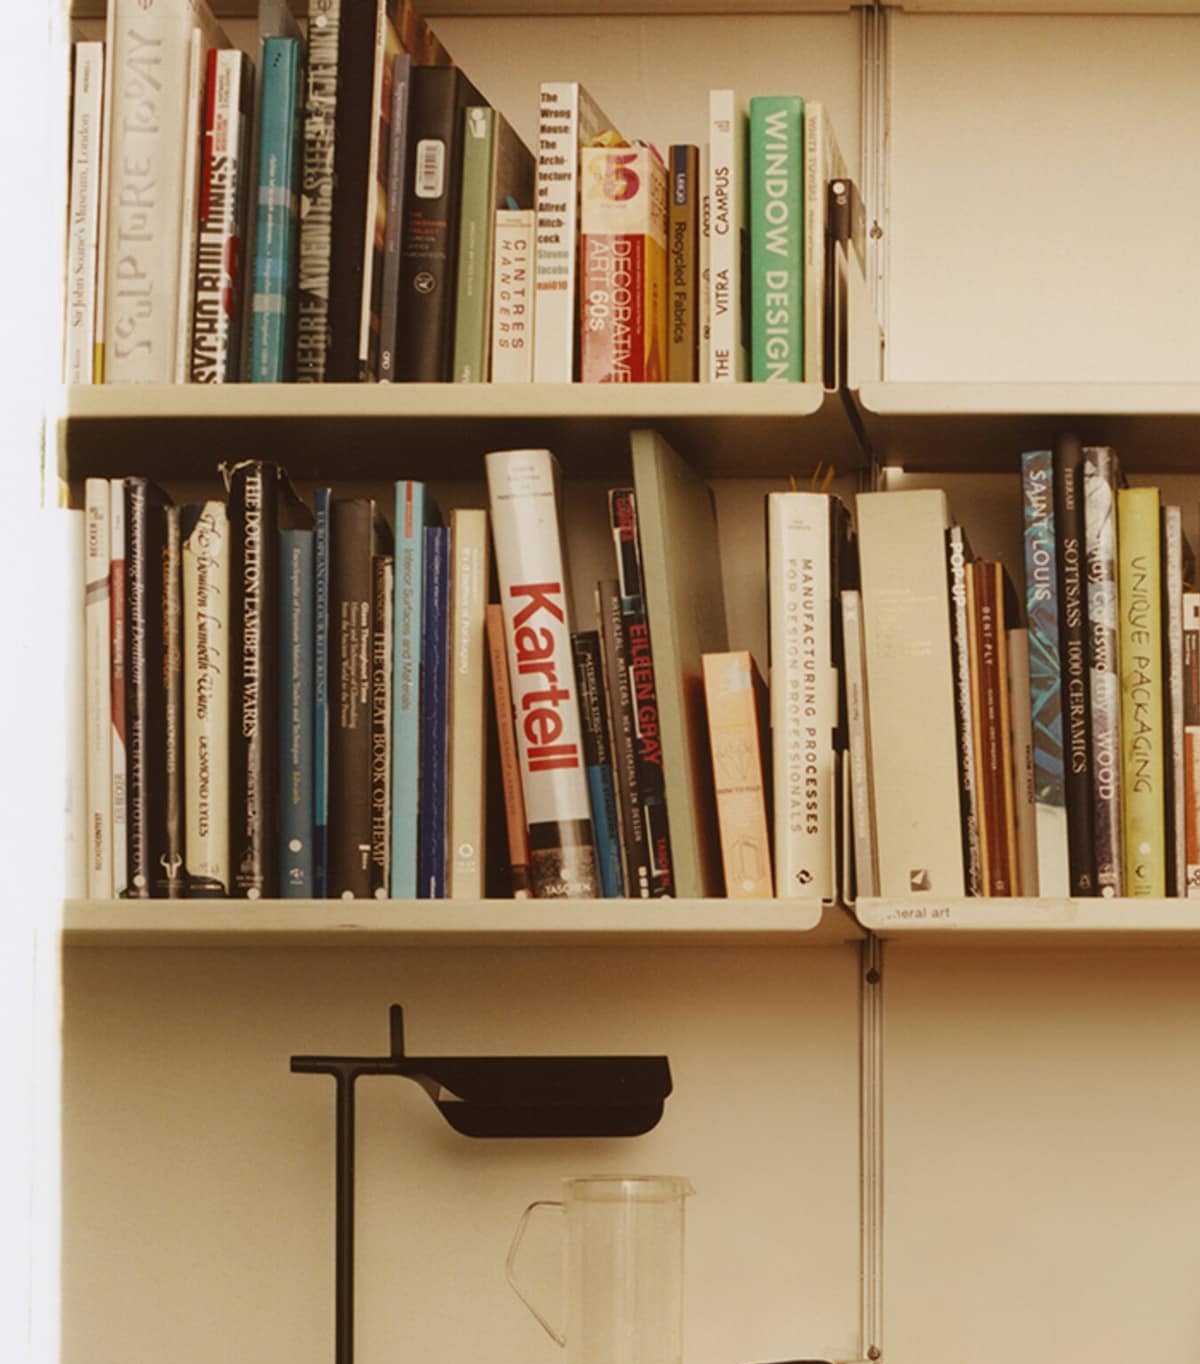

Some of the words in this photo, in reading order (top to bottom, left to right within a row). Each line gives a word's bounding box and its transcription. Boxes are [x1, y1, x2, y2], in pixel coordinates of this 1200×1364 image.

[540, 109, 571, 120] Wrong
[541, 93, 557, 102] The
[77, 113, 90, 164] London
[539, 156, 566, 165] Archi-
[540, 140, 557, 149] The
[74, 167, 89, 224] Museum,
[538, 171, 572, 181] tecture
[538, 187, 548, 196] of
[714, 167, 729, 235] CAMPUS
[765, 110, 789, 257] WINDOW
[538, 202, 566, 212] Alfred
[538, 218, 565, 228] Hitch-
[74, 228, 87, 274] Soane's
[537, 233, 560, 244] cock
[589, 240, 610, 287] ART
[671, 221, 687, 286] Recycled
[72, 278, 87, 308] John
[499, 240, 512, 349] HANGERS
[512, 240, 527, 349] CINTRES
[589, 290, 610, 331] 60s
[611, 240, 632, 383] DECORATIVE
[673, 291, 687, 344] Fabrics
[715, 268, 729, 316] VITRA
[71, 311, 83, 328] Sir
[765, 270, 789, 383] DESIGN
[716, 349, 729, 379] THE
[244, 475, 262, 512] THE
[129, 493, 146, 576] Discovering
[243, 512, 262, 597] DOULTON
[197, 556, 221, 608] Doulton
[403, 548, 414, 585] Interior
[786, 558, 797, 594] FOR
[949, 542, 966, 608] POP-UP
[1063, 539, 1081, 629] SOTTSASS
[129, 582, 146, 624] Royal
[360, 602, 369, 627] Glass
[402, 589, 414, 635] Surfaces
[1128, 556, 1150, 645] UNIQUE
[131, 626, 146, 684] Doulton
[197, 612, 222, 675] Lambeth
[243, 597, 261, 678] LAMBETH
[359, 629, 369, 680] Throughout
[373, 631, 386, 664] THE
[401, 638, 413, 659] and
[629, 623, 655, 701] EILEEN
[785, 603, 798, 670] DESIGN
[802, 558, 817, 718] MANUFACTURING
[1068, 639, 1083, 675] 1000
[360, 681, 369, 704] Time
[373, 670, 386, 727] GREAT
[401, 661, 413, 711] Materials
[510, 582, 579, 772] Kartell
[242, 678, 260, 738] WARES
[1068, 679, 1087, 775] CERAMICS
[1130, 656, 1153, 794] PACKAGING
[132, 719, 142, 788] MICHAEL
[373, 732, 386, 783] BOOK
[638, 704, 661, 766] GRAY
[788, 678, 802, 835] PROFESSIONALS
[198, 735, 209, 799] DESMOND
[804, 728, 818, 836] PROCESSES
[1097, 731, 1114, 800] WOOD
[198, 803, 209, 838] EYLES
[373, 788, 386, 811] OF
[132, 797, 143, 876] DOULTON
[372, 816, 386, 866] HEMP
[931, 908, 950, 919] art
